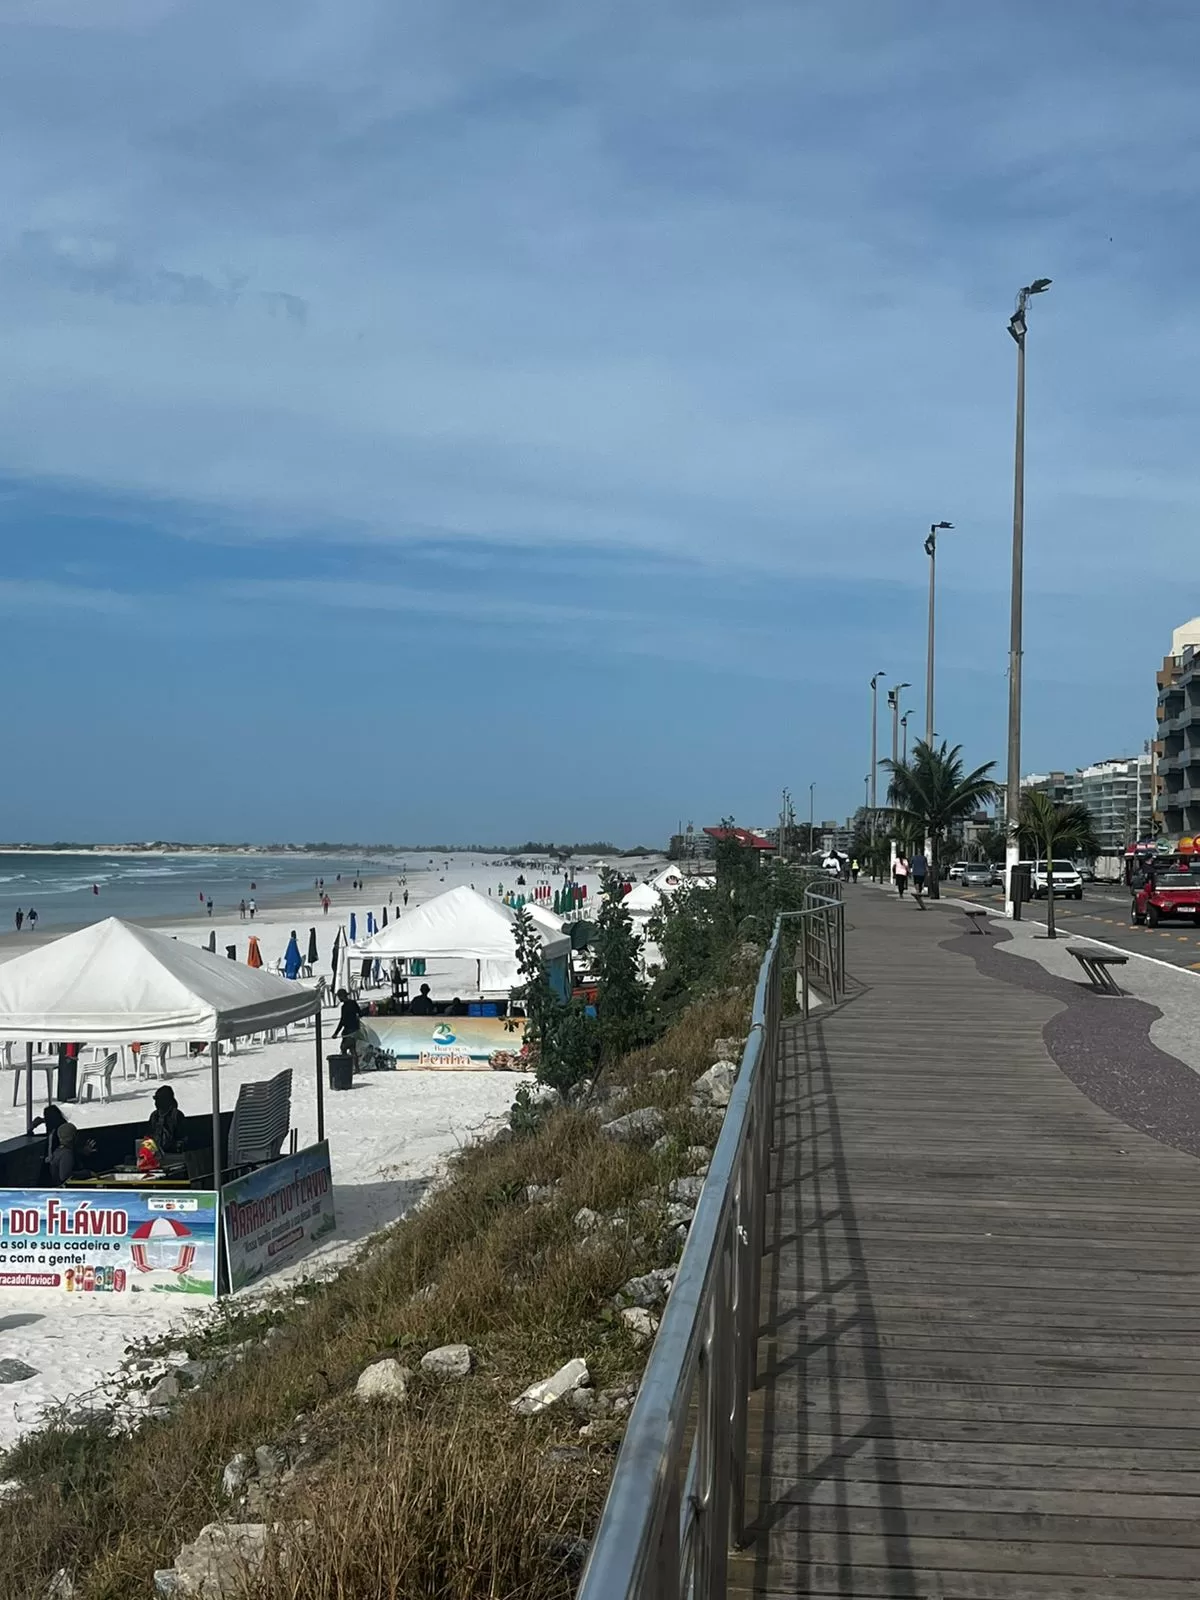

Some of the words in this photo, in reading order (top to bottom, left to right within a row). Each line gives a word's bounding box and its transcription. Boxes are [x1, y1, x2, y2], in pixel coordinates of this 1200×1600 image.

[419, 1052, 471, 1065] Penha
[10, 1209, 39, 1234] DO
[48, 1199, 127, 1235] FLÁVIO
[11, 1240, 27, 1250] sol
[30, 1241, 38, 1250] e
[41, 1241, 61, 1250] sua
[64, 1240, 110, 1251] cadeira
[113, 1242, 121, 1251] e
[10, 1254, 35, 1263] com
[38, 1255, 46, 1264] a
[48, 1254, 86, 1266] gente!
